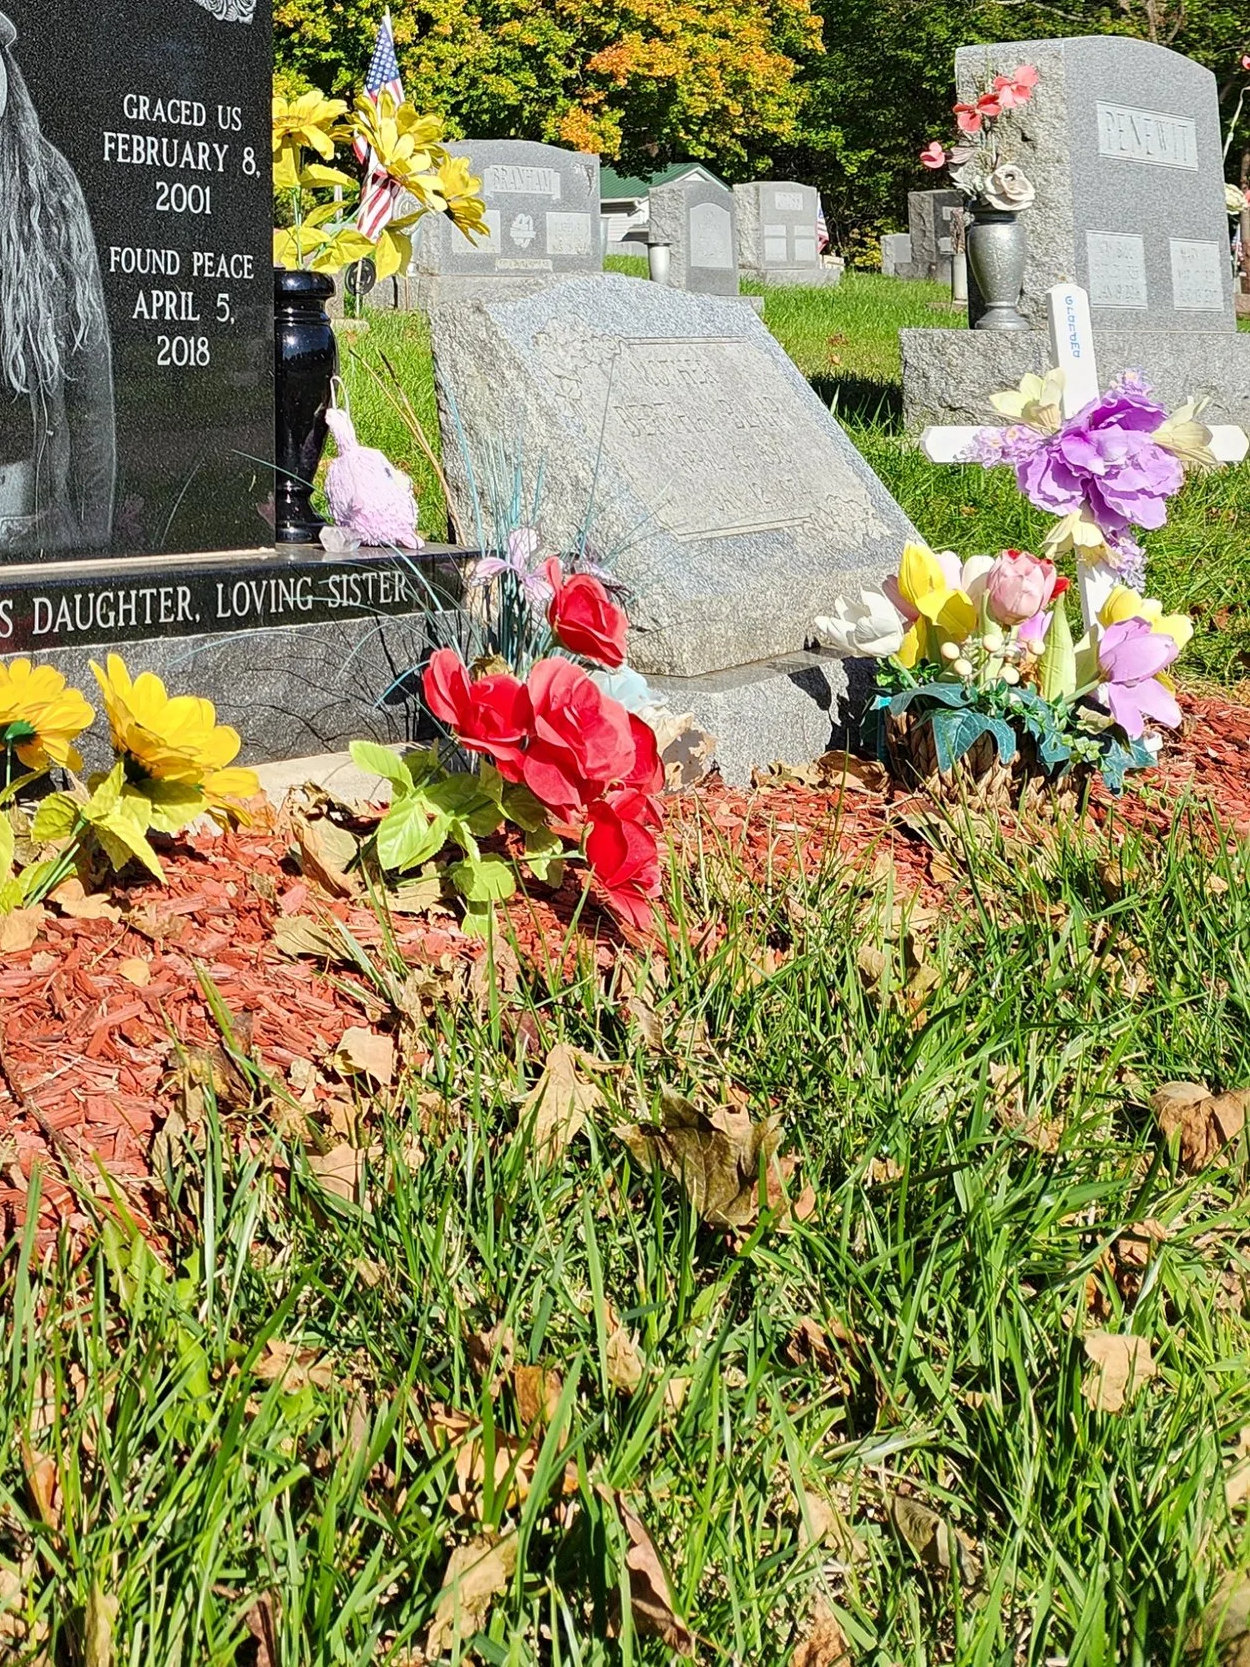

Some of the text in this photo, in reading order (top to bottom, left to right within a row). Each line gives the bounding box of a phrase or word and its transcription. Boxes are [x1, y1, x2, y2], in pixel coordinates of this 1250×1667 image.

[123, 93, 242, 132] GRACED US
[103, 131, 261, 179] FEBRUARY 8,
[493, 167, 552, 192] BRANHAM
[155, 181, 212, 215] 2001
[108, 246, 254, 280] FOUND PEACE
[132, 289, 235, 325] APRIL 5,
[156, 334, 211, 367] 2018
[31, 585, 201, 635] DAUGHTER,
[215, 576, 314, 619] LOVING
[327, 570, 408, 609] SISTER
